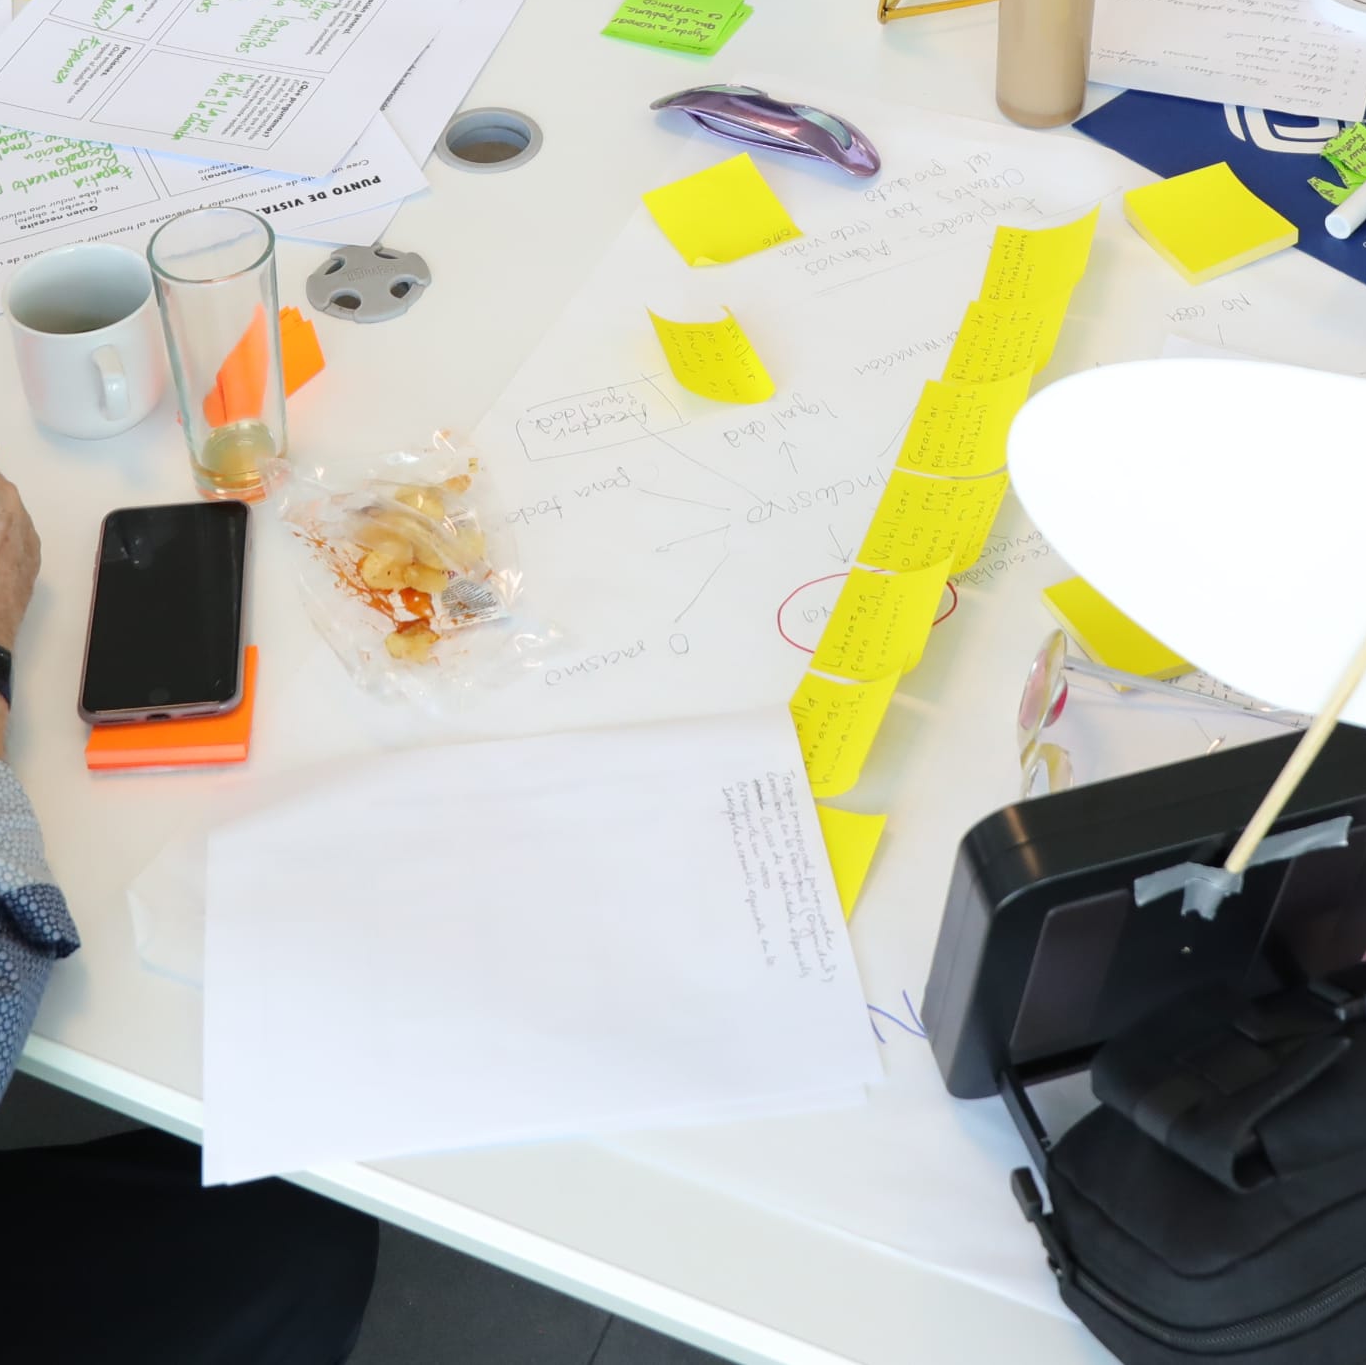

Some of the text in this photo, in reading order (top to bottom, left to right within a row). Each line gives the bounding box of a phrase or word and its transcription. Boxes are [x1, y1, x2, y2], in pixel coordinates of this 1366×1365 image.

[256, 176, 380, 215] PUNTO DE VISTA.
